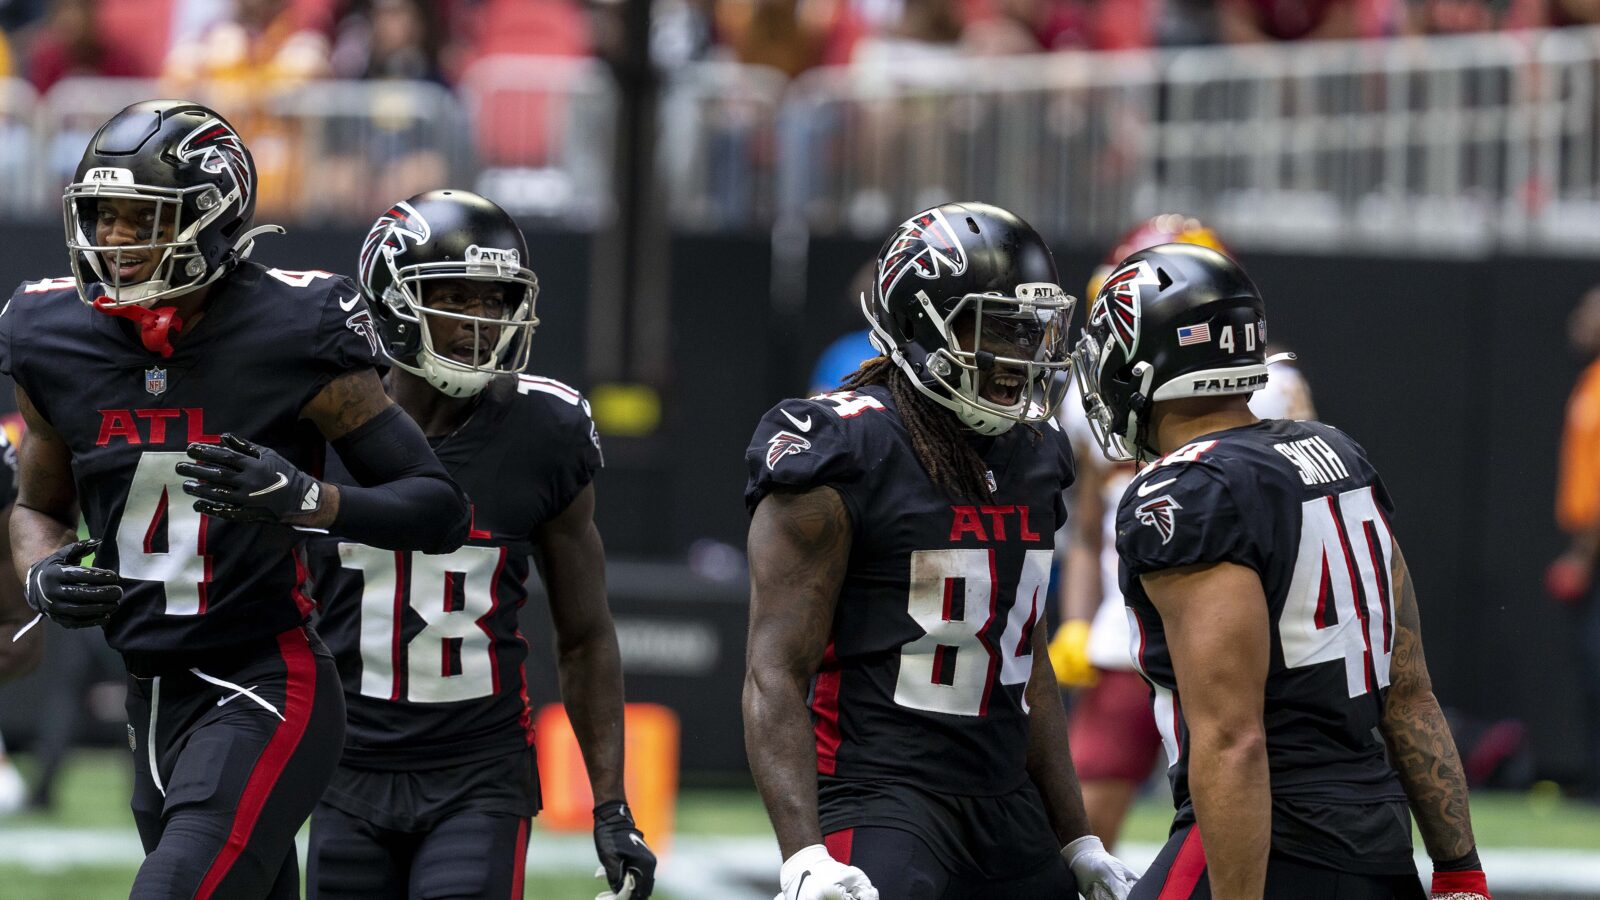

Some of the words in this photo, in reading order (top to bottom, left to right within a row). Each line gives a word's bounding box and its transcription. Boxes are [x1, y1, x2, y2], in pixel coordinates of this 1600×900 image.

[93, 170, 118, 179] ATL
[481, 251, 506, 262] ATL
[1034, 287, 1055, 297] ATL
[95, 407, 223, 447] ATL
[1273, 435, 1350, 486] SMITH
[115, 450, 214, 616] 4
[949, 505, 1041, 542] ATL
[1278, 485, 1396, 699] 40
[337, 542, 508, 703] 18
[893, 548, 1056, 717] 84
